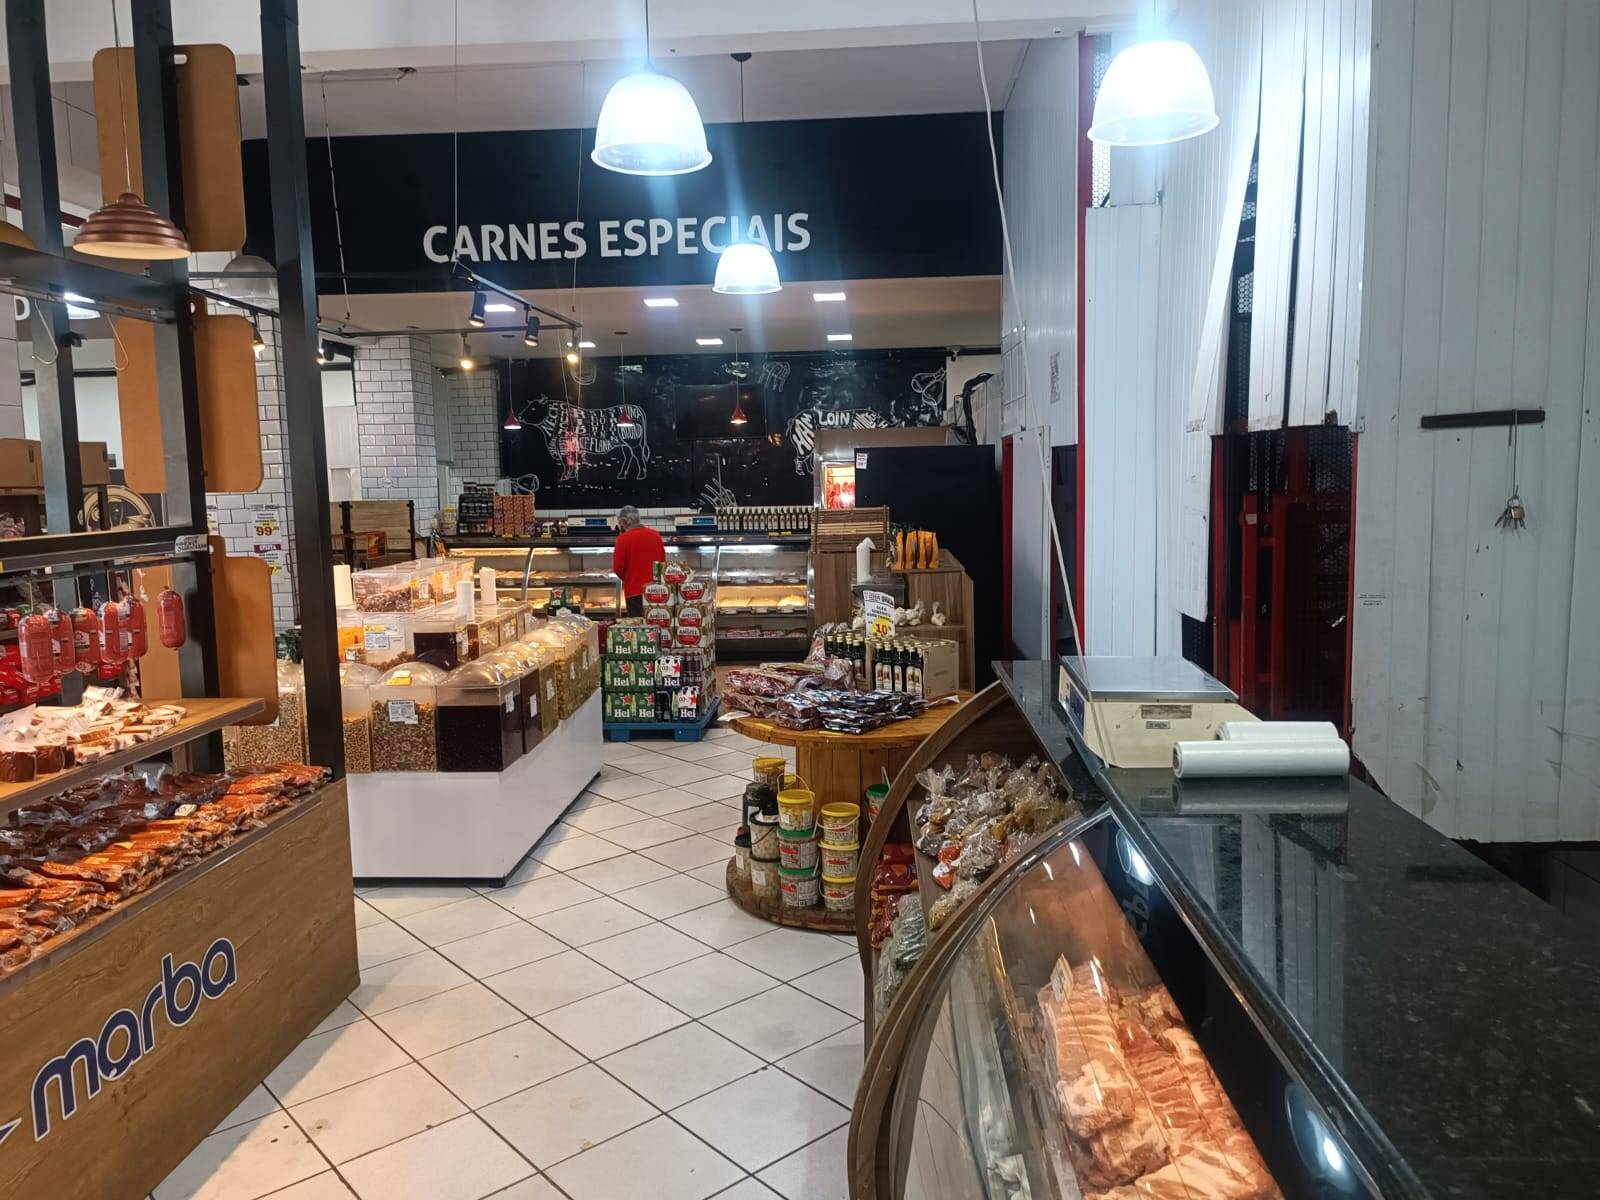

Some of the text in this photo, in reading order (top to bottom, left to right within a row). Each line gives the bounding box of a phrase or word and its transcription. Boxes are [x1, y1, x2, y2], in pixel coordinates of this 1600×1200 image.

[422, 212, 811, 264] CARNES ESPECIAIS
[792, 412, 816, 456] HAM
[818, 410, 850, 426] LOIN
[31, 937, 238, 1142] marba
